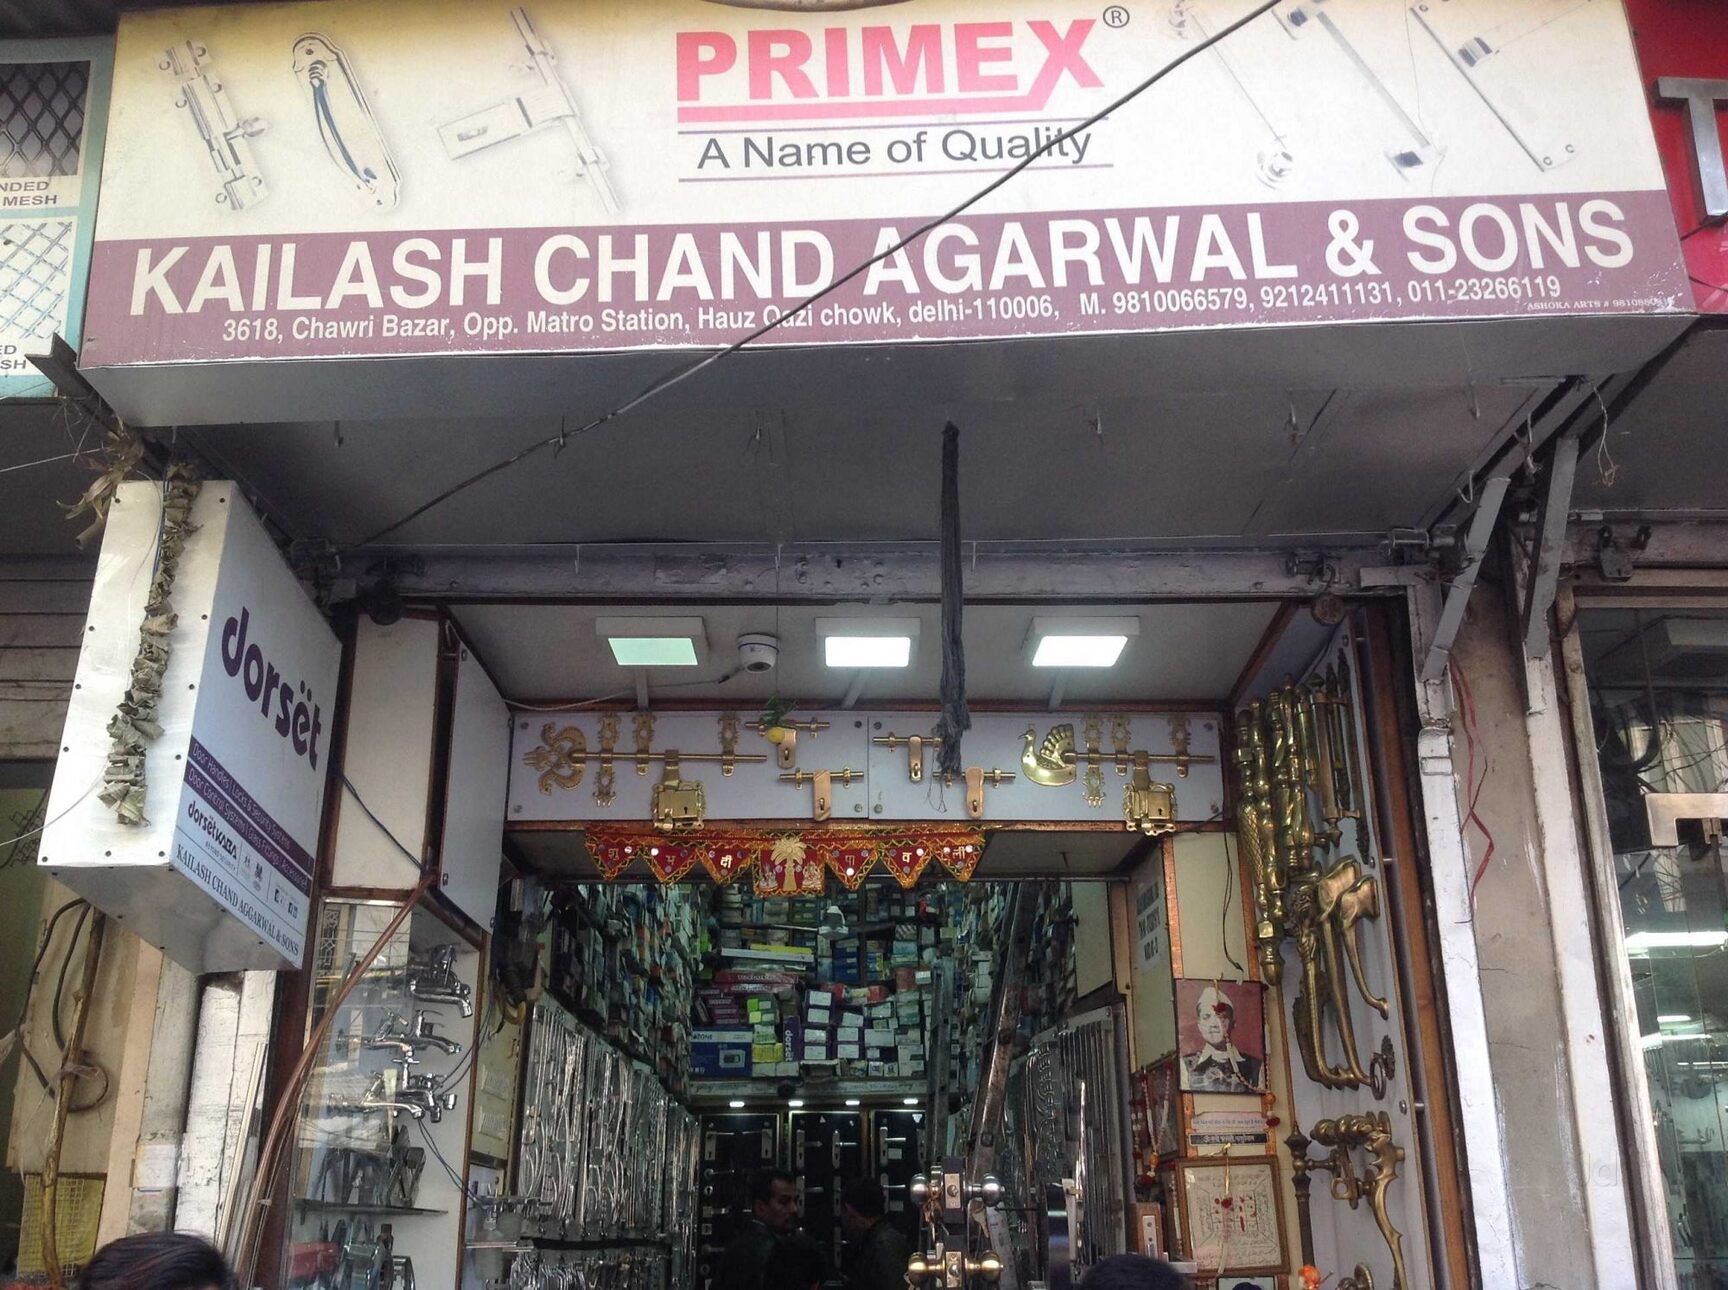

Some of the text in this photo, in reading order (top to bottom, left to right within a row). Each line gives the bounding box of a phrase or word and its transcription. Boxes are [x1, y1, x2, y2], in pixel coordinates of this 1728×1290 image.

[676, 19, 1104, 101] PRIMEX
[697, 126, 1092, 169] A Name of Quality
[2, 195, 57, 207] MESH
[130, 199, 1634, 315] KAILASH CHAND AGARWAL & SONS
[222, 318, 283, 344] 3618,
[292, 314, 374, 341] Chawri
[382, 315, 455, 341] Bazar,
[463, 312, 518, 341] Opp.
[527, 311, 594, 333] Matro
[601, 308, 690, 334] Station,
[698, 306, 755, 329] Hauz
[820, 301, 902, 327] chowk,
[909, 295, 1060, 323] delhi-110006,
[1080, 293, 1106, 315] M.
[1115, 287, 1255, 314] 9810066579,
[1261, 282, 1402, 308] 9212411131,
[1408, 276, 1560, 302] 011-23266119
[189, 768, 203, 787] Door
[193, 743, 207, 763] Door
[208, 759, 230, 788] Handles
[177, 844, 211, 885] KAILASH
[212, 876, 238, 907] CHAND
[237, 900, 276, 940] AGGARWAL
[282, 934, 299, 956] SONS
